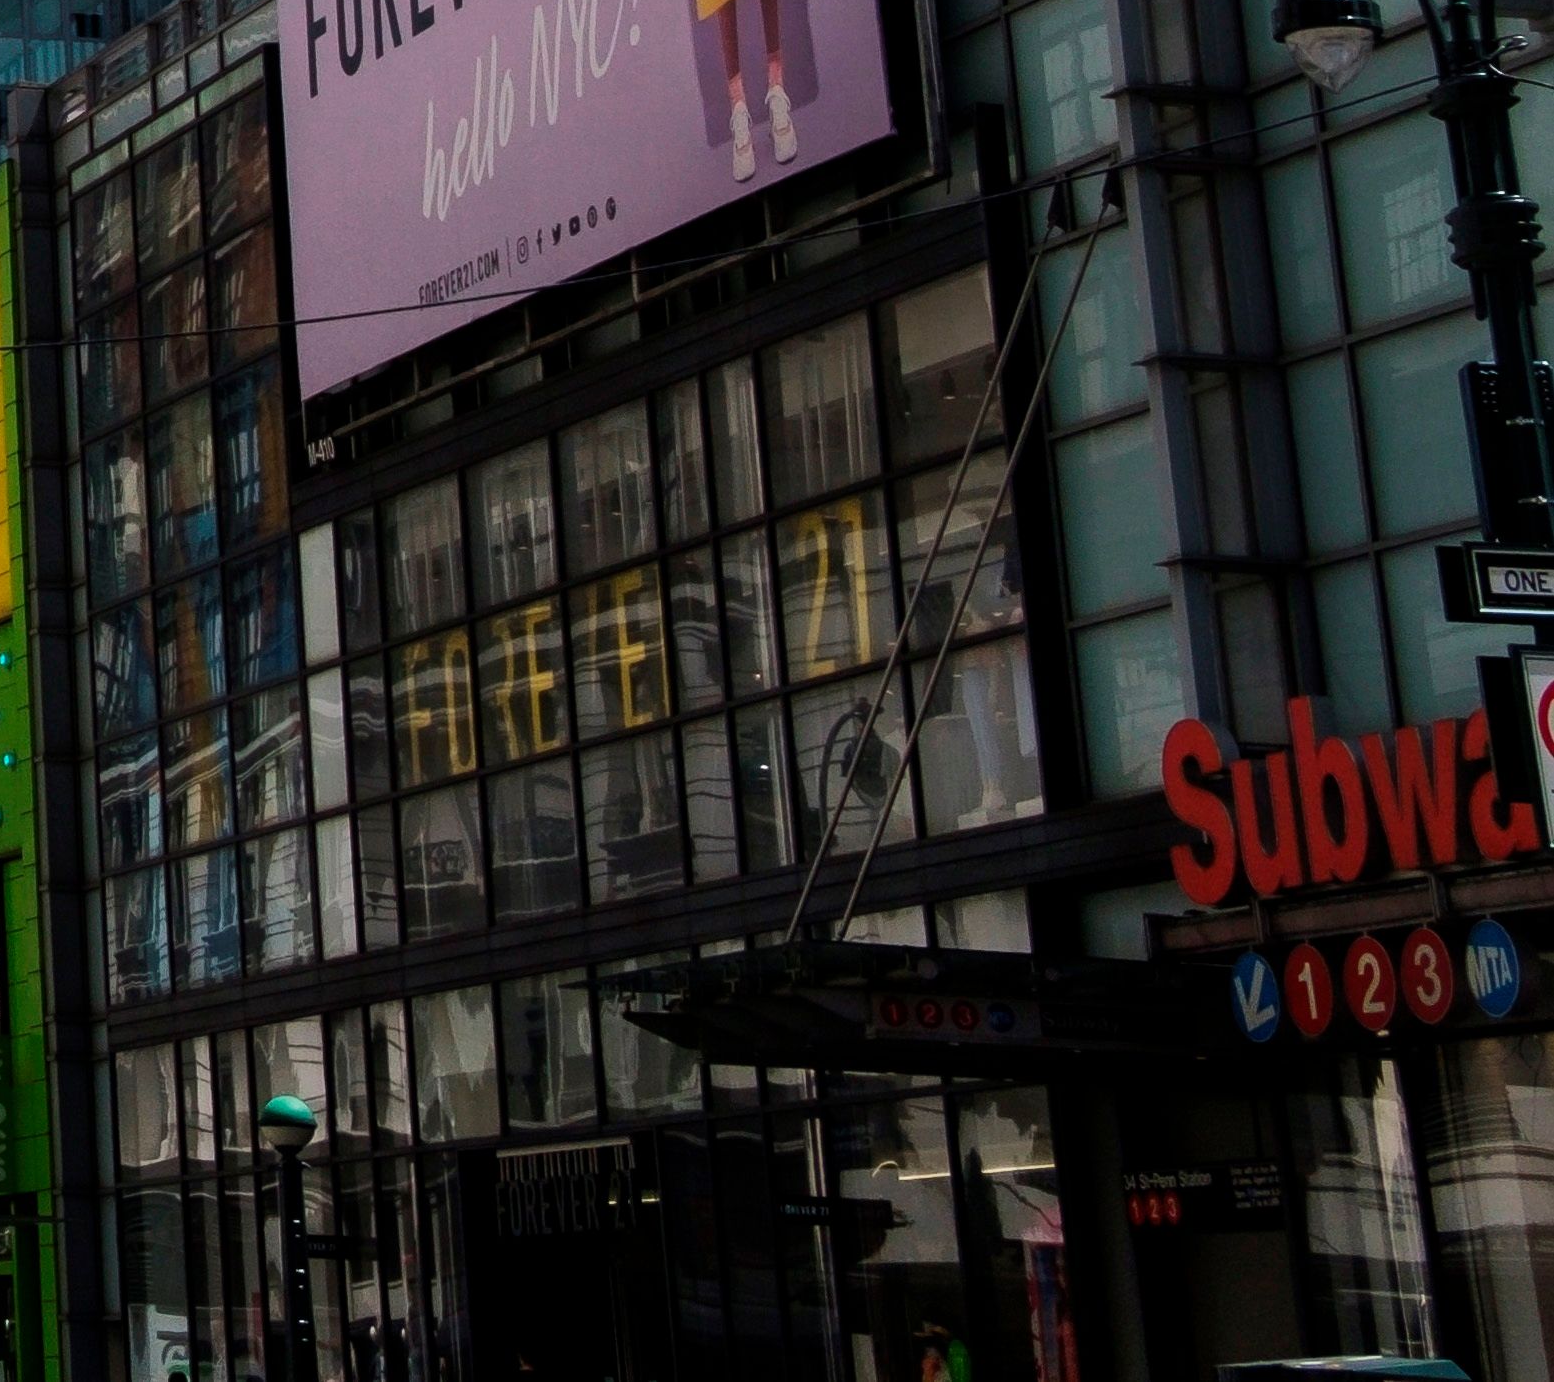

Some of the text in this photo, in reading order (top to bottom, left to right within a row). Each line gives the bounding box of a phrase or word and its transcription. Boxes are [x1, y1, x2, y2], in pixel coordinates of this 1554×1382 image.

[423, 36, 514, 221] hello
[419, 247, 499, 311] FOREVER21.COM
[795, 496, 873, 678] 21
[1504, 569, 1554, 594] ONE
[1298, 945, 1511, 1020] 1 2 3 MTA
[496, 1173, 601, 1237] FOREVER
